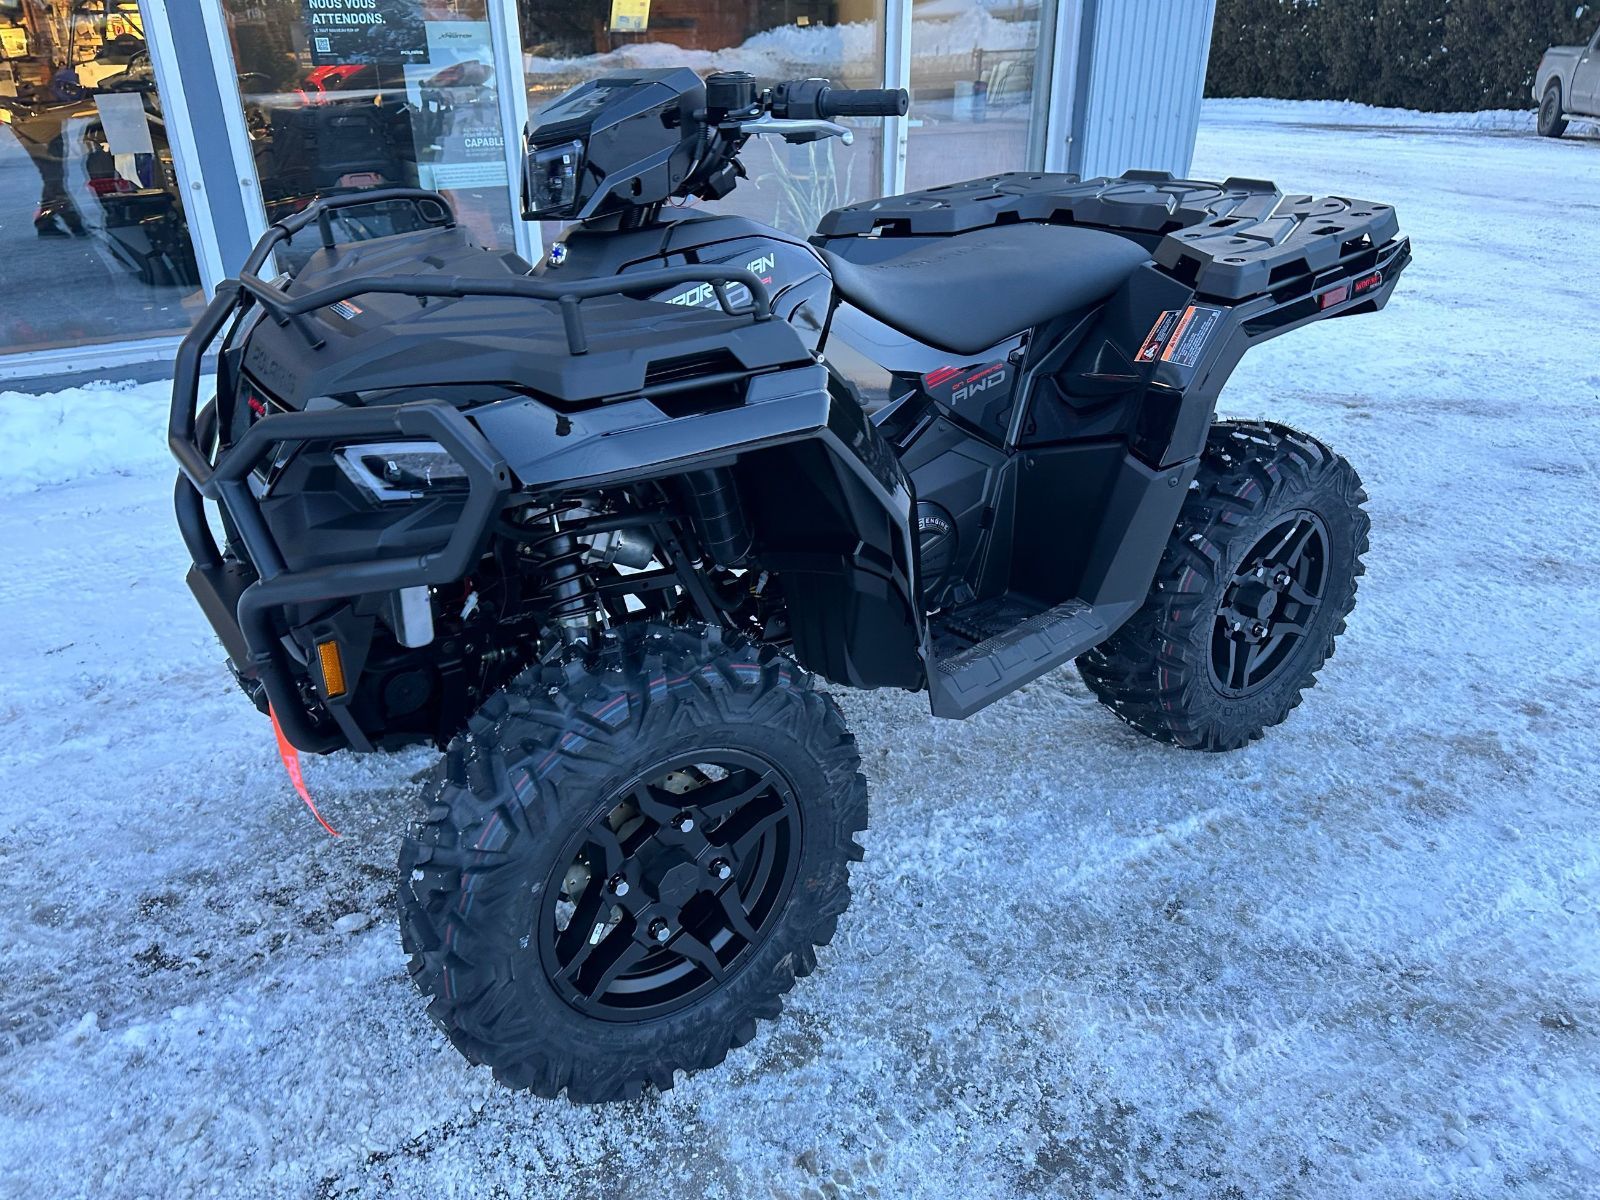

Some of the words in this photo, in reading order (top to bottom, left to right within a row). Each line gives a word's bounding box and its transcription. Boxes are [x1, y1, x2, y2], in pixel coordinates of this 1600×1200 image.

[309, 0, 342, 9] NOUS
[345, 0, 376, 9] VOUS
[312, 13, 386, 25] ATTENDONS.
[464, 137, 504, 148] CAPABLE
[951, 370, 1006, 406] AWD
